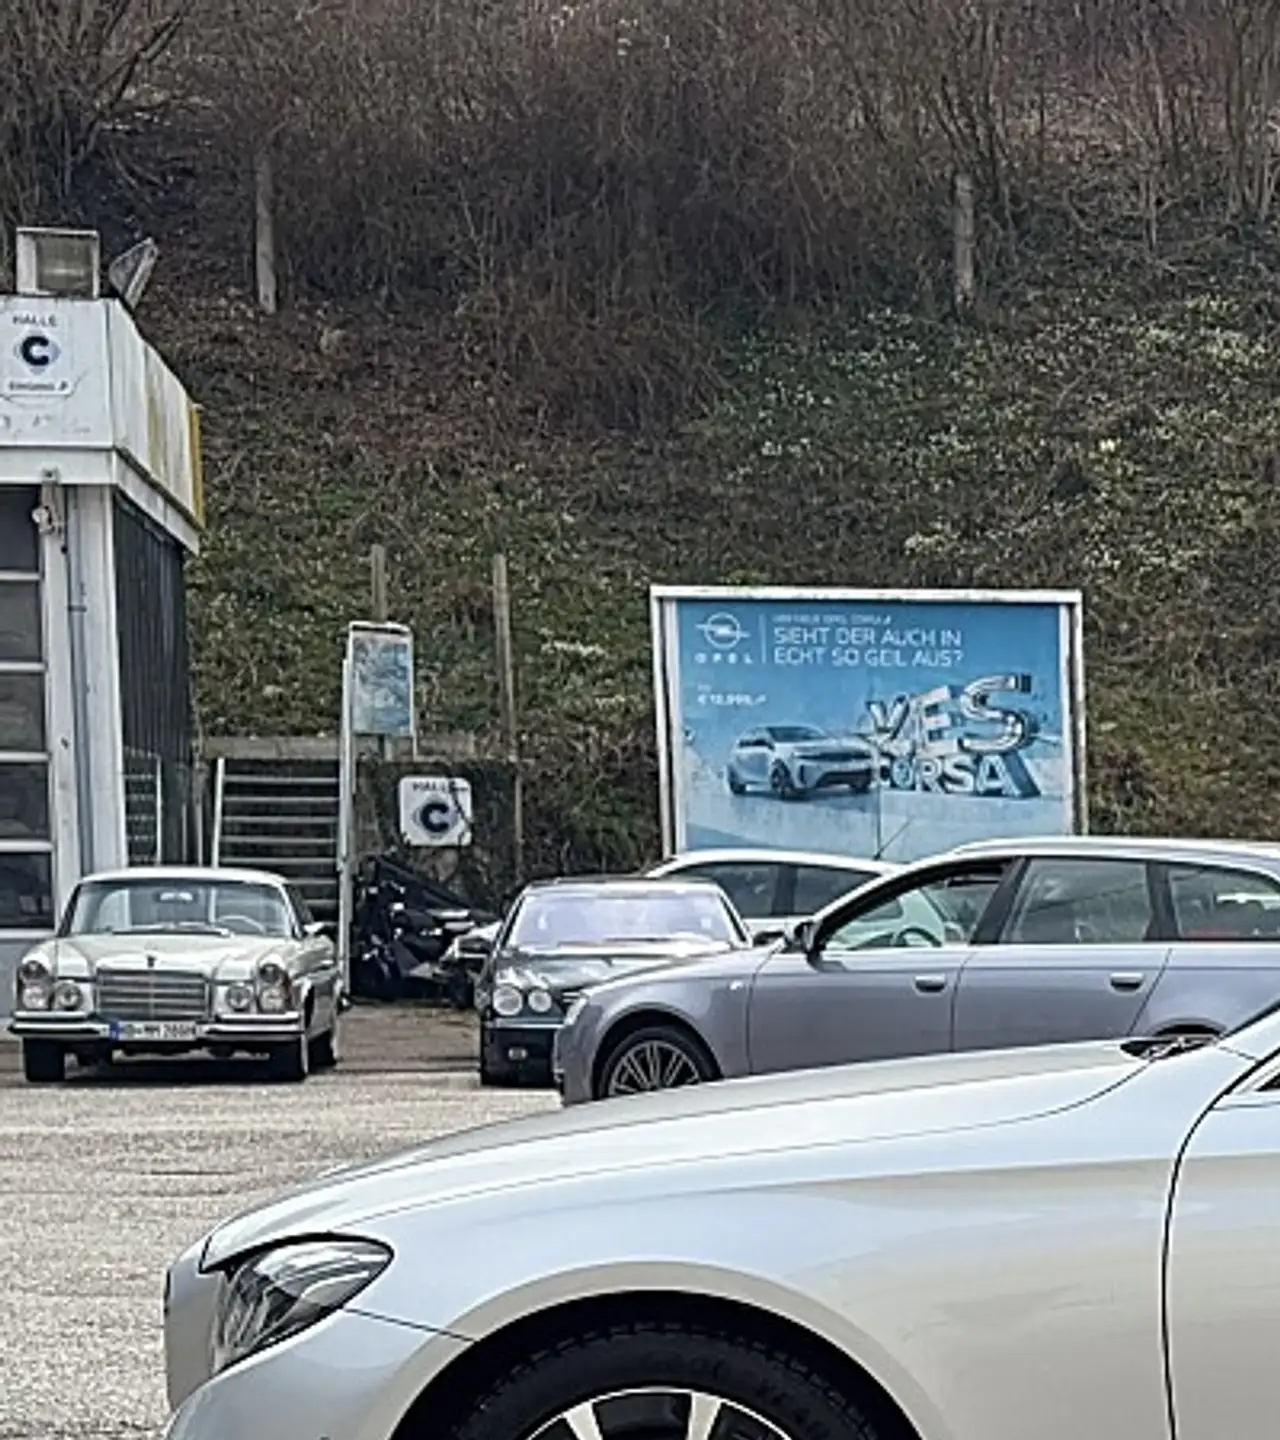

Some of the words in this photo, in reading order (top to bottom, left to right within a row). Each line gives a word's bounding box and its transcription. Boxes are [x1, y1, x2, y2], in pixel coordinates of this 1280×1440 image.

[21, 335, 50, 367] C
[773, 626, 830, 645] SIEHT
[835, 627, 876, 646] DER
[880, 628, 936, 647] AUCH
[941, 629, 962, 648] IN
[693, 652, 753, 665] OPEL
[773, 647, 826, 666] ECHT
[831, 648, 859, 667] SO
[864, 648, 907, 667] GEIL
[912, 649, 964, 668] AUS?
[420, 802, 450, 833] C
